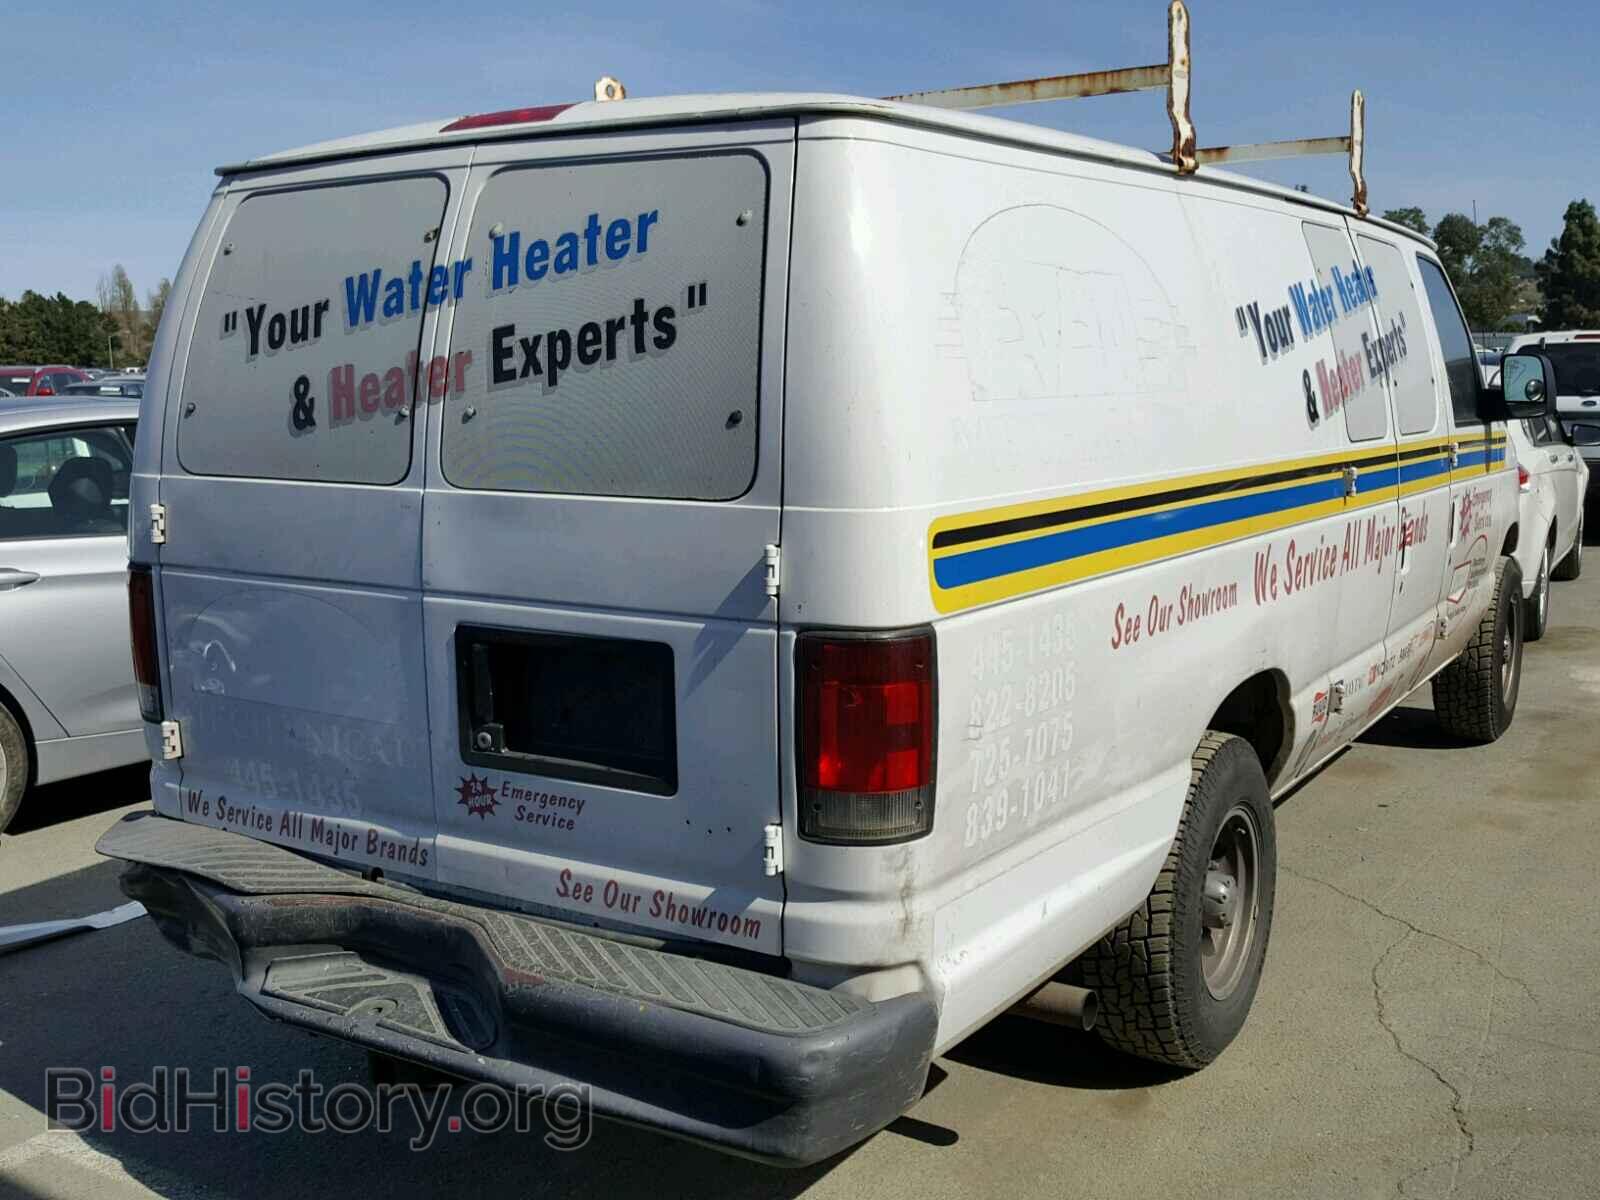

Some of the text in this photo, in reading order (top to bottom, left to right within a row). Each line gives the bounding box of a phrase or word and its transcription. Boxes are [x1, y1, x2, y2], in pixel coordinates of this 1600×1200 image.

[222, 209, 660, 357] "Your Water Heater
[1235, 300, 1295, 360] "Your
[1288, 279, 1338, 338] Water
[290, 281, 709, 434] & Heater Experts"
[1302, 368, 1320, 425] &
[1315, 350, 1366, 418] Heater
[1111, 601, 1142, 650] See
[1148, 594, 1174, 637] Our
[1177, 581, 1238, 627] Showroom
[1253, 542, 1278, 606] We
[1283, 534, 1338, 596] Service
[1341, 518, 1363, 574] All
[1364, 513, 1396, 575] Major
[187, 789, 429, 867] We Service All Major Brands
[501, 780, 586, 816] Emergency
[514, 804, 576, 831] Service
[556, 867, 762, 940] See Our Showroom
